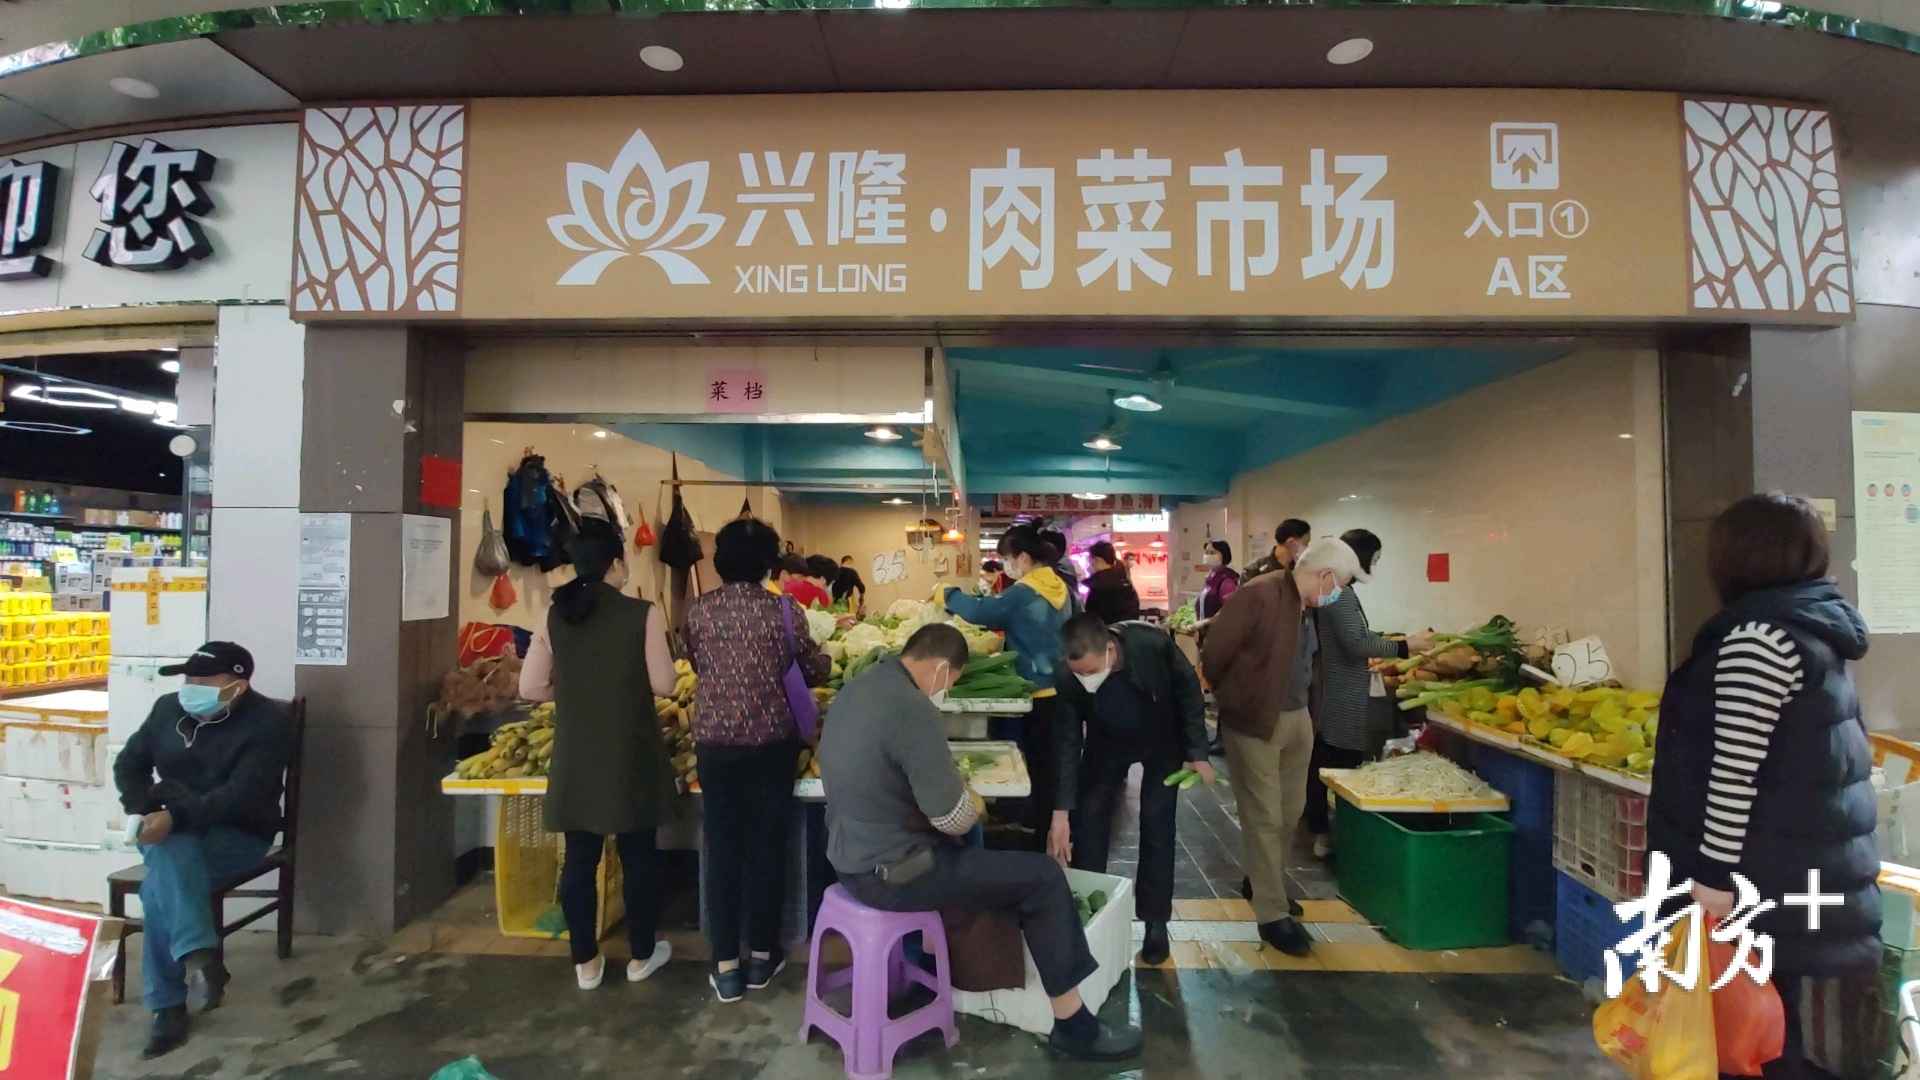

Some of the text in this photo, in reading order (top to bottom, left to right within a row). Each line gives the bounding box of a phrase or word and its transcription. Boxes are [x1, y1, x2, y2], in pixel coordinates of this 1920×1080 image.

[734, 263, 907, 294] XING LONG
[1486, 255, 1572, 299] A区
[710, 380, 763, 401] 菜档
